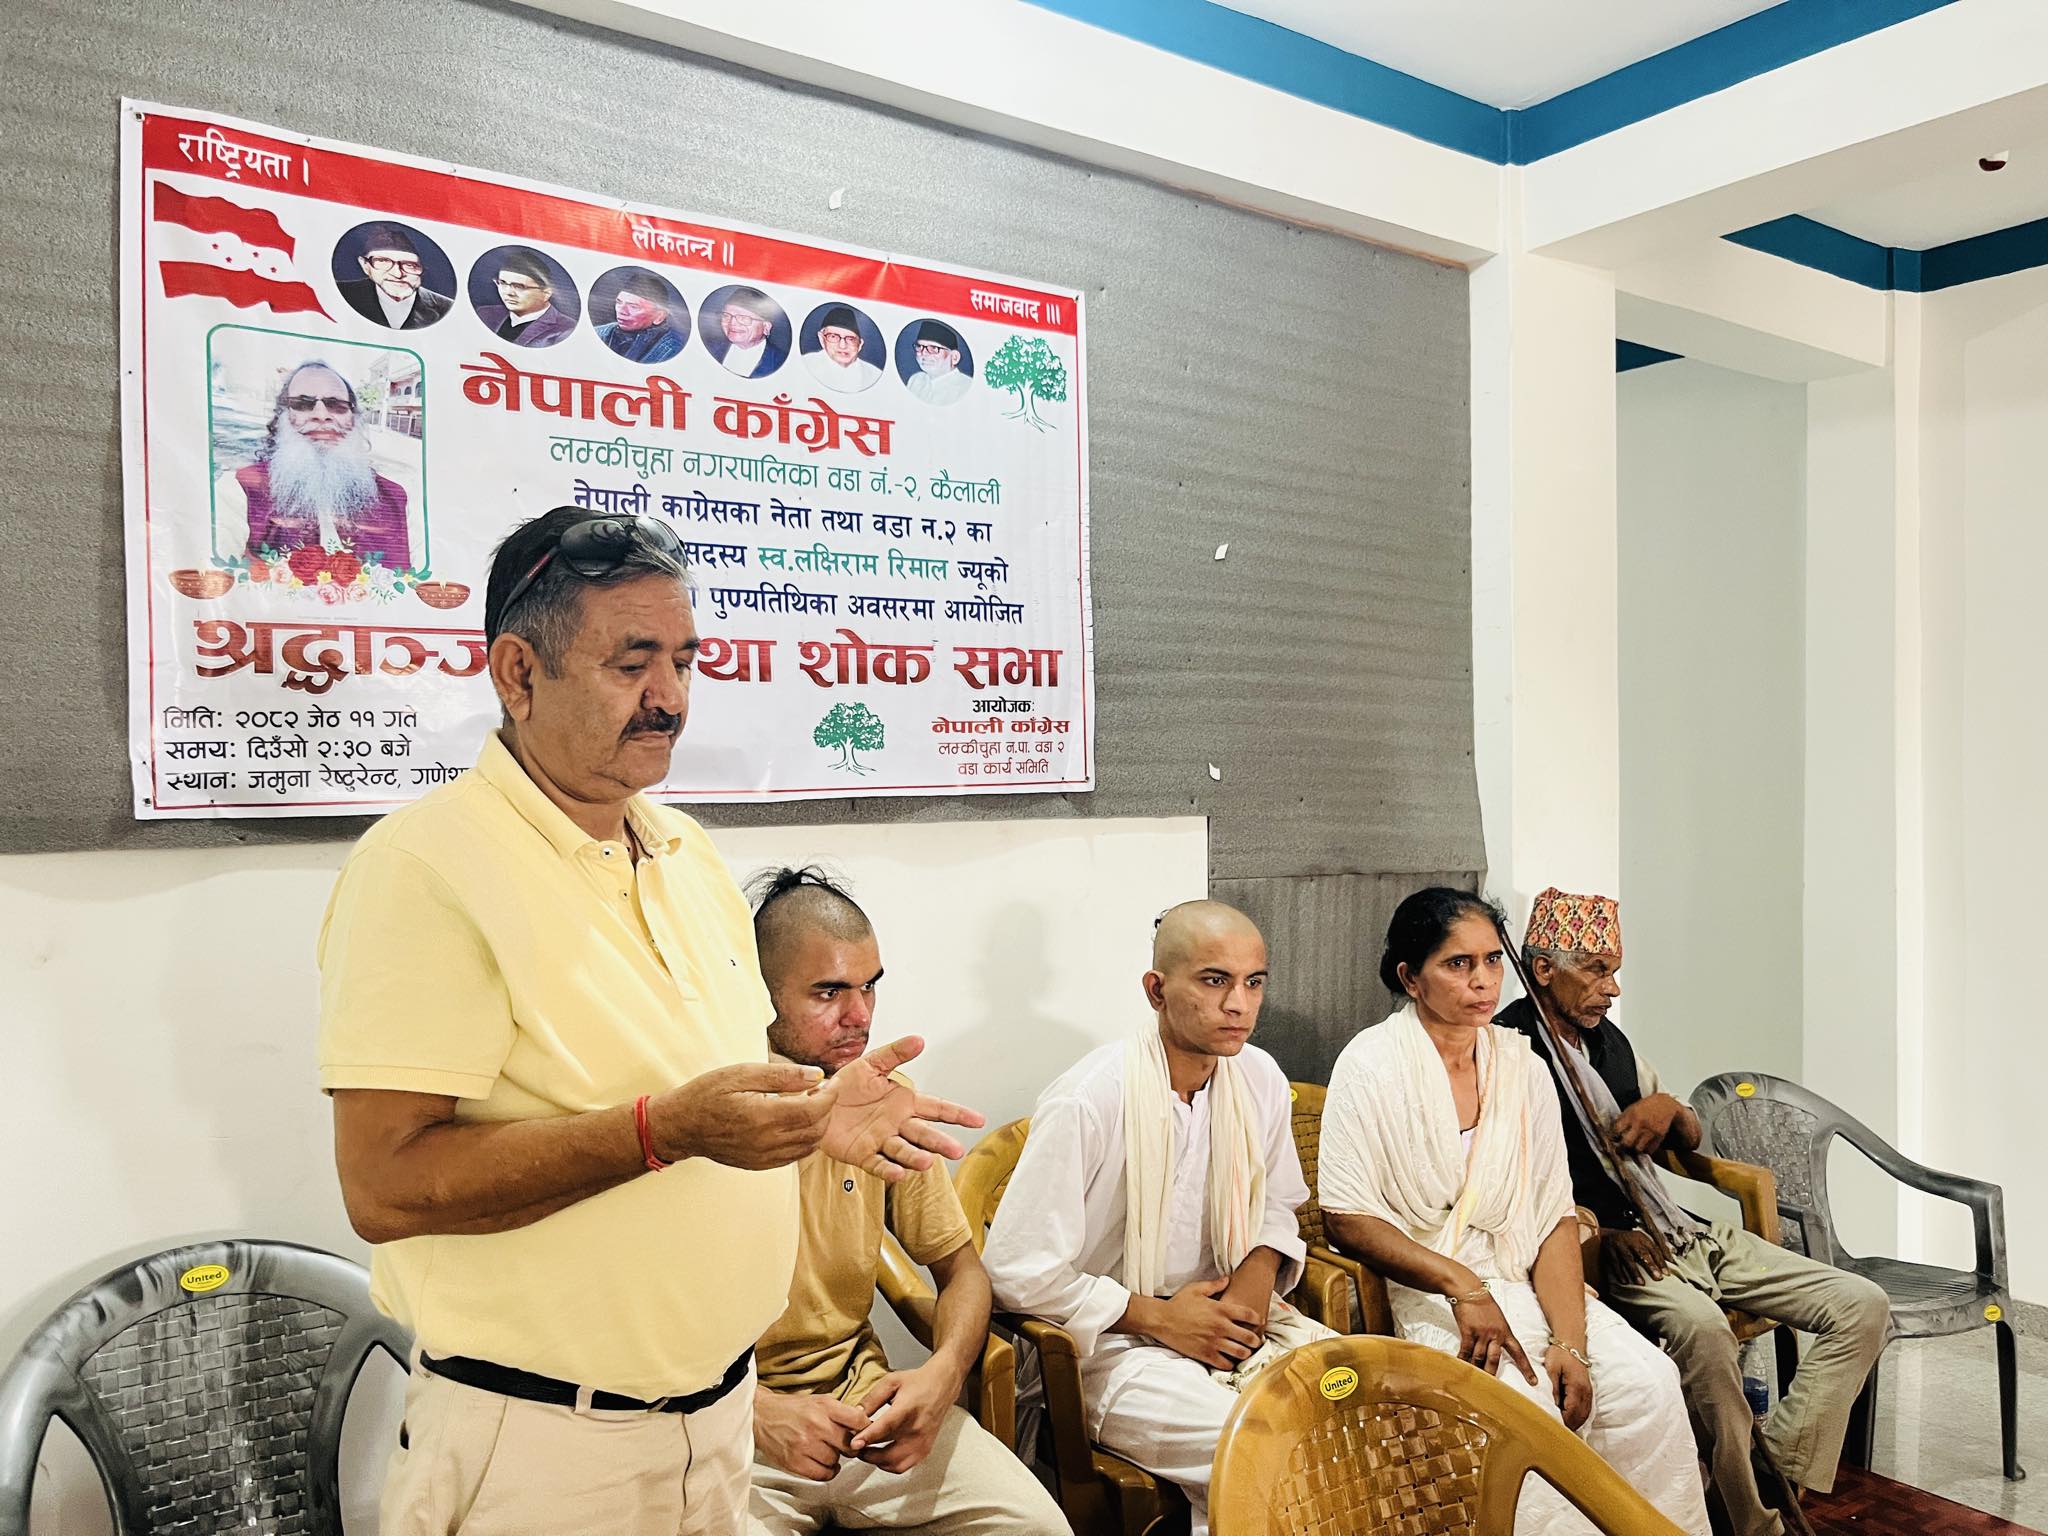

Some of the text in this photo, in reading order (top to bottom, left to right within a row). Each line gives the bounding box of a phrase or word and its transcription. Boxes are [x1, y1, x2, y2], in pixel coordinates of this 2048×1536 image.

[178, 128, 292, 179] राष्ट्रियता
[631, 219, 716, 261] लोकतन्त्र
[970, 289, 1040, 323] समाजवाद
[460, 351, 895, 456] नेपाली काँग्रेस
[549, 436, 674, 479] लम्कीचुहा
[683, 450, 819, 488] नगरपालिका
[827, 467, 862, 492] वडा
[930, 469, 1002, 505] कैलाली
[574, 479, 651, 515] नेपाली
[770, 498, 812, 529] नेता
[821, 510, 863, 533] तथा
[872, 514, 912, 538] वडा
[966, 522, 992, 543] का
[684, 542, 748, 569] सदस्य
[888, 548, 949, 581] रिमाल
[957, 557, 1009, 590] ज्यूको
[709, 582, 838, 620] पुण्यतिथिका
[848, 595, 935, 621] अवसरमा
[945, 595, 1025, 624] आयोजित
[697, 637, 777, 682] था
[798, 628, 934, 688] शोक
[953, 647, 1063, 690] सभा
[235, 711, 299, 729] २०८२
[307, 704, 342, 728] जेठ
[350, 711, 375, 727] ११
[383, 705, 418, 728] गते
[931, 716, 1070, 735] नेपाली काँग्रेस
[247, 734, 308, 760] दिउँसो
[317, 741, 372, 758] २:३०
[380, 734, 412, 757] बजे
[938, 739, 1001, 758] लम्कीचुहा
[1034, 741, 1053, 753] वडा
[1057, 741, 1065, 753] २
[248, 770, 311, 795] जमुना
[958, 757, 1049, 775] वडा कार्य समिति
[187, 1271, 222, 1284] United
[1324, 1375, 1353, 1392] United
